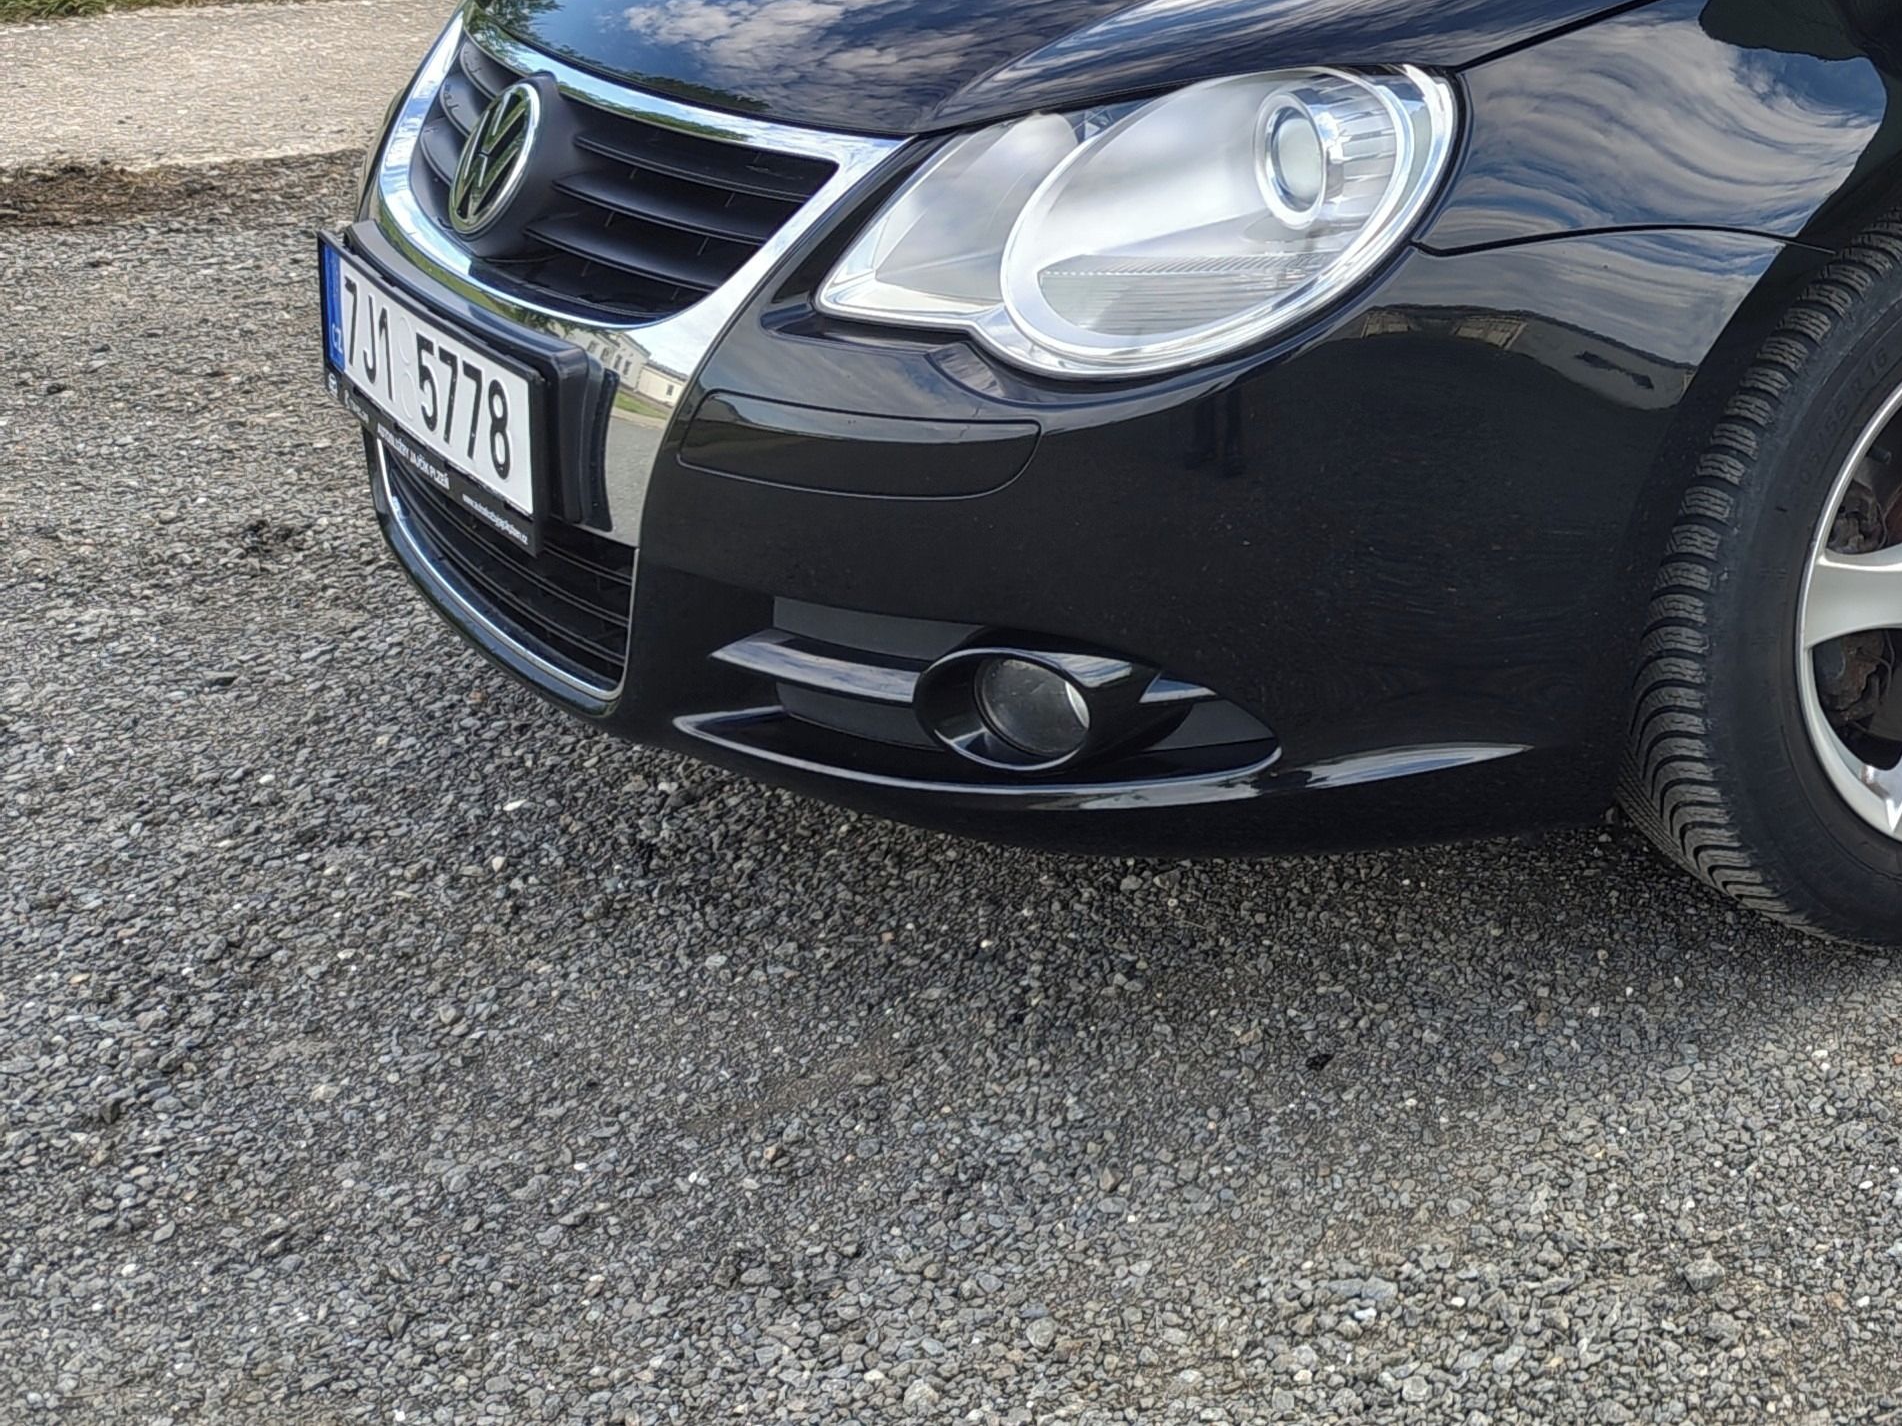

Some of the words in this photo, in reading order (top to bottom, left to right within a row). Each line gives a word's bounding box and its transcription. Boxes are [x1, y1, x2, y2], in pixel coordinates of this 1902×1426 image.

[332, 322, 344, 355] CZ
[344, 275, 394, 403] 7J1
[415, 331, 512, 481] 5778
